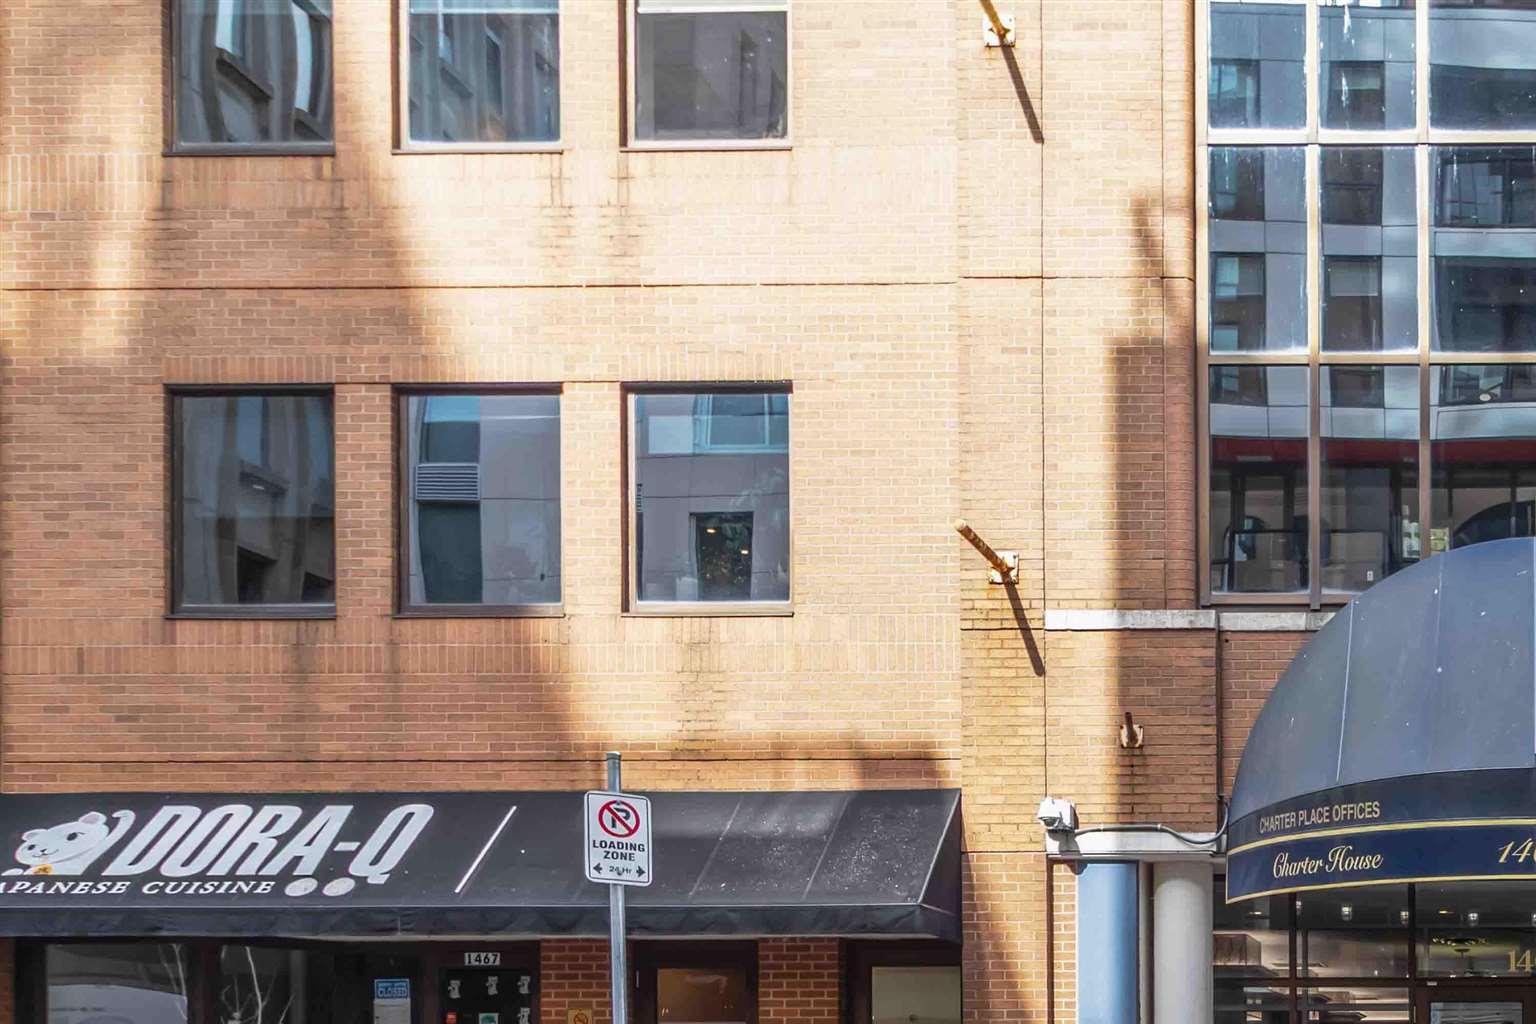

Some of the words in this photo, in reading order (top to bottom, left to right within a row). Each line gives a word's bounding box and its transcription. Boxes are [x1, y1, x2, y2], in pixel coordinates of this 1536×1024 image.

[1259, 811, 1297, 834] CHARTER
[1298, 806, 1330, 826] PLACE
[1332, 801, 1381, 820] OFFICES
[101, 804, 435, 884] DORA-Q
[592, 840, 646, 853] LOADING
[603, 850, 636, 862] ZONE
[1273, 852, 1324, 879] Charter
[1325, 846, 1384, 873] House
[142, 881, 276, 894] CUISINE
[467, 953, 499, 965] 1467
